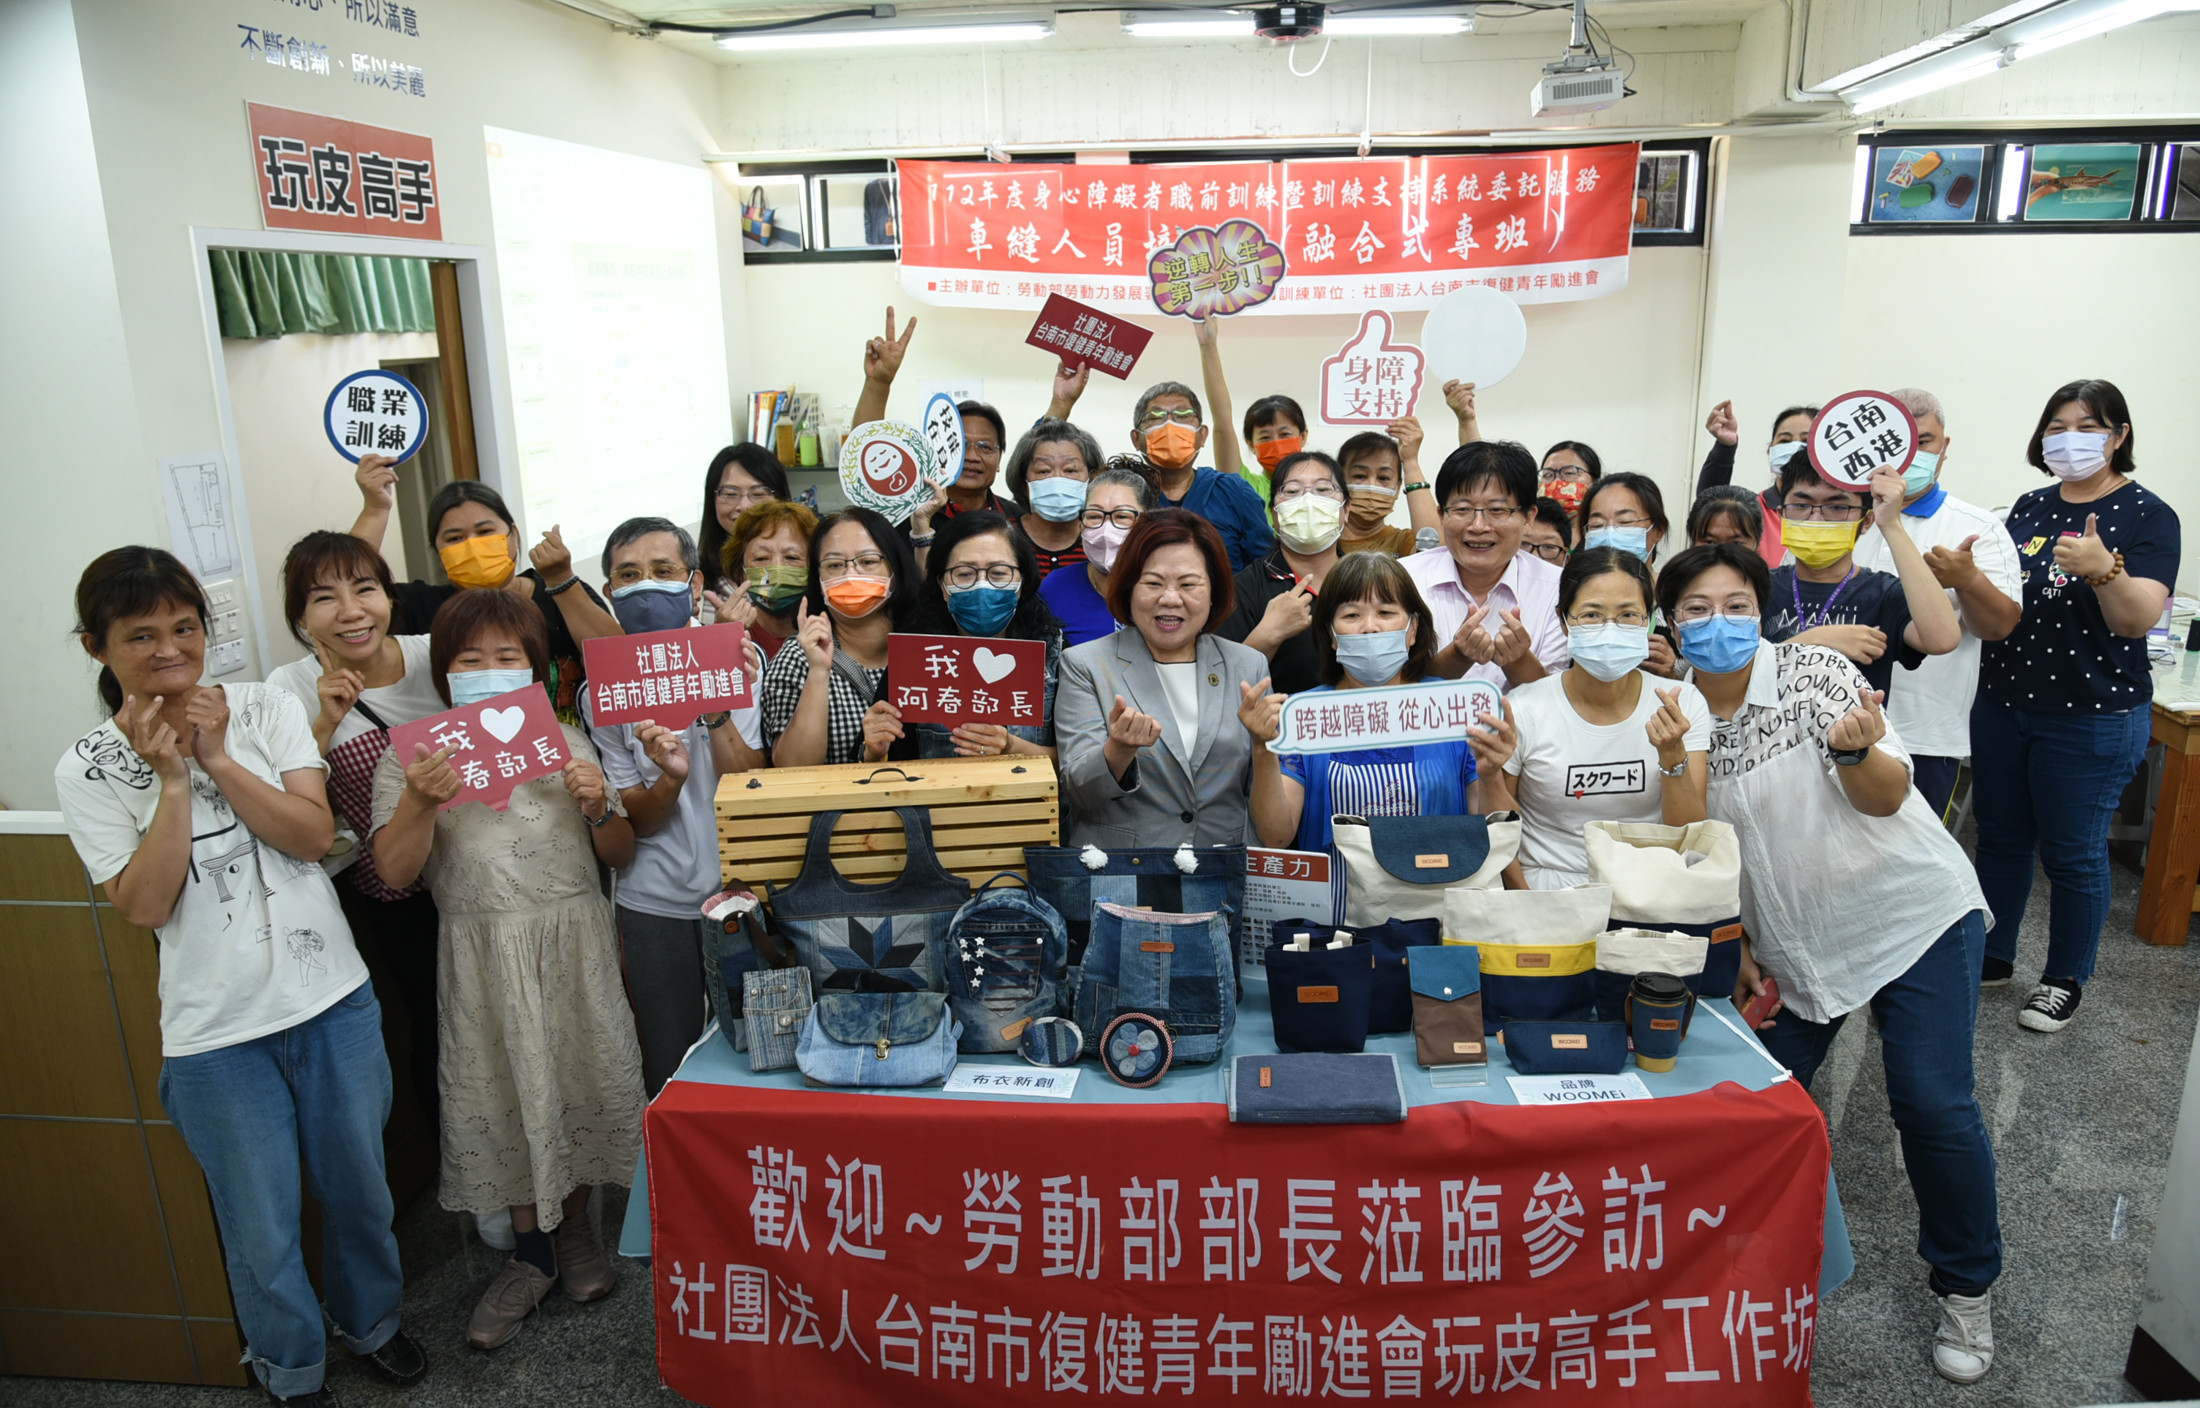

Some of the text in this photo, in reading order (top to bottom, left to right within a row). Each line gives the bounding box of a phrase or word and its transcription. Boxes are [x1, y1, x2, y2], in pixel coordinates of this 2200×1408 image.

[260, 136, 436, 223] 玩皮高手
[1164, 240, 1261, 282] 逆轉人生
[1169, 264, 1263, 306] 第一步!!
[1073, 312, 1117, 344] 社團法人
[1034, 321, 1134, 372] 台南市復健青年勵進會
[1344, 355, 1405, 386] 身障
[347, 386, 408, 416] 職業
[1343, 388, 1404, 418] 支持
[345, 420, 407, 451] 訓練
[1823, 400, 1887, 451] 台南
[1839, 429, 1907, 481] 西港
[636, 640, 699, 675] 社團法人
[924, 644, 960, 678] 我
[597, 666, 744, 713] 台南市復健青年勵進會
[898, 686, 1033, 718] 阿春部長
[1295, 692, 1491, 742] 跨越障礙 從心出發
[429, 721, 475, 758] 我
[460, 736, 561, 789] 春部長
[1572, 768, 1638, 789] スクワード
[972, 1074, 1055, 1089] 布衣新創
[1543, 1089, 1626, 1101] WOOMEi
[1561, 1079, 1596, 1090] 品牌
[669, 1261, 1814, 1398] 社團法人台南市復健青年勵進會玩皮高手工作坊
